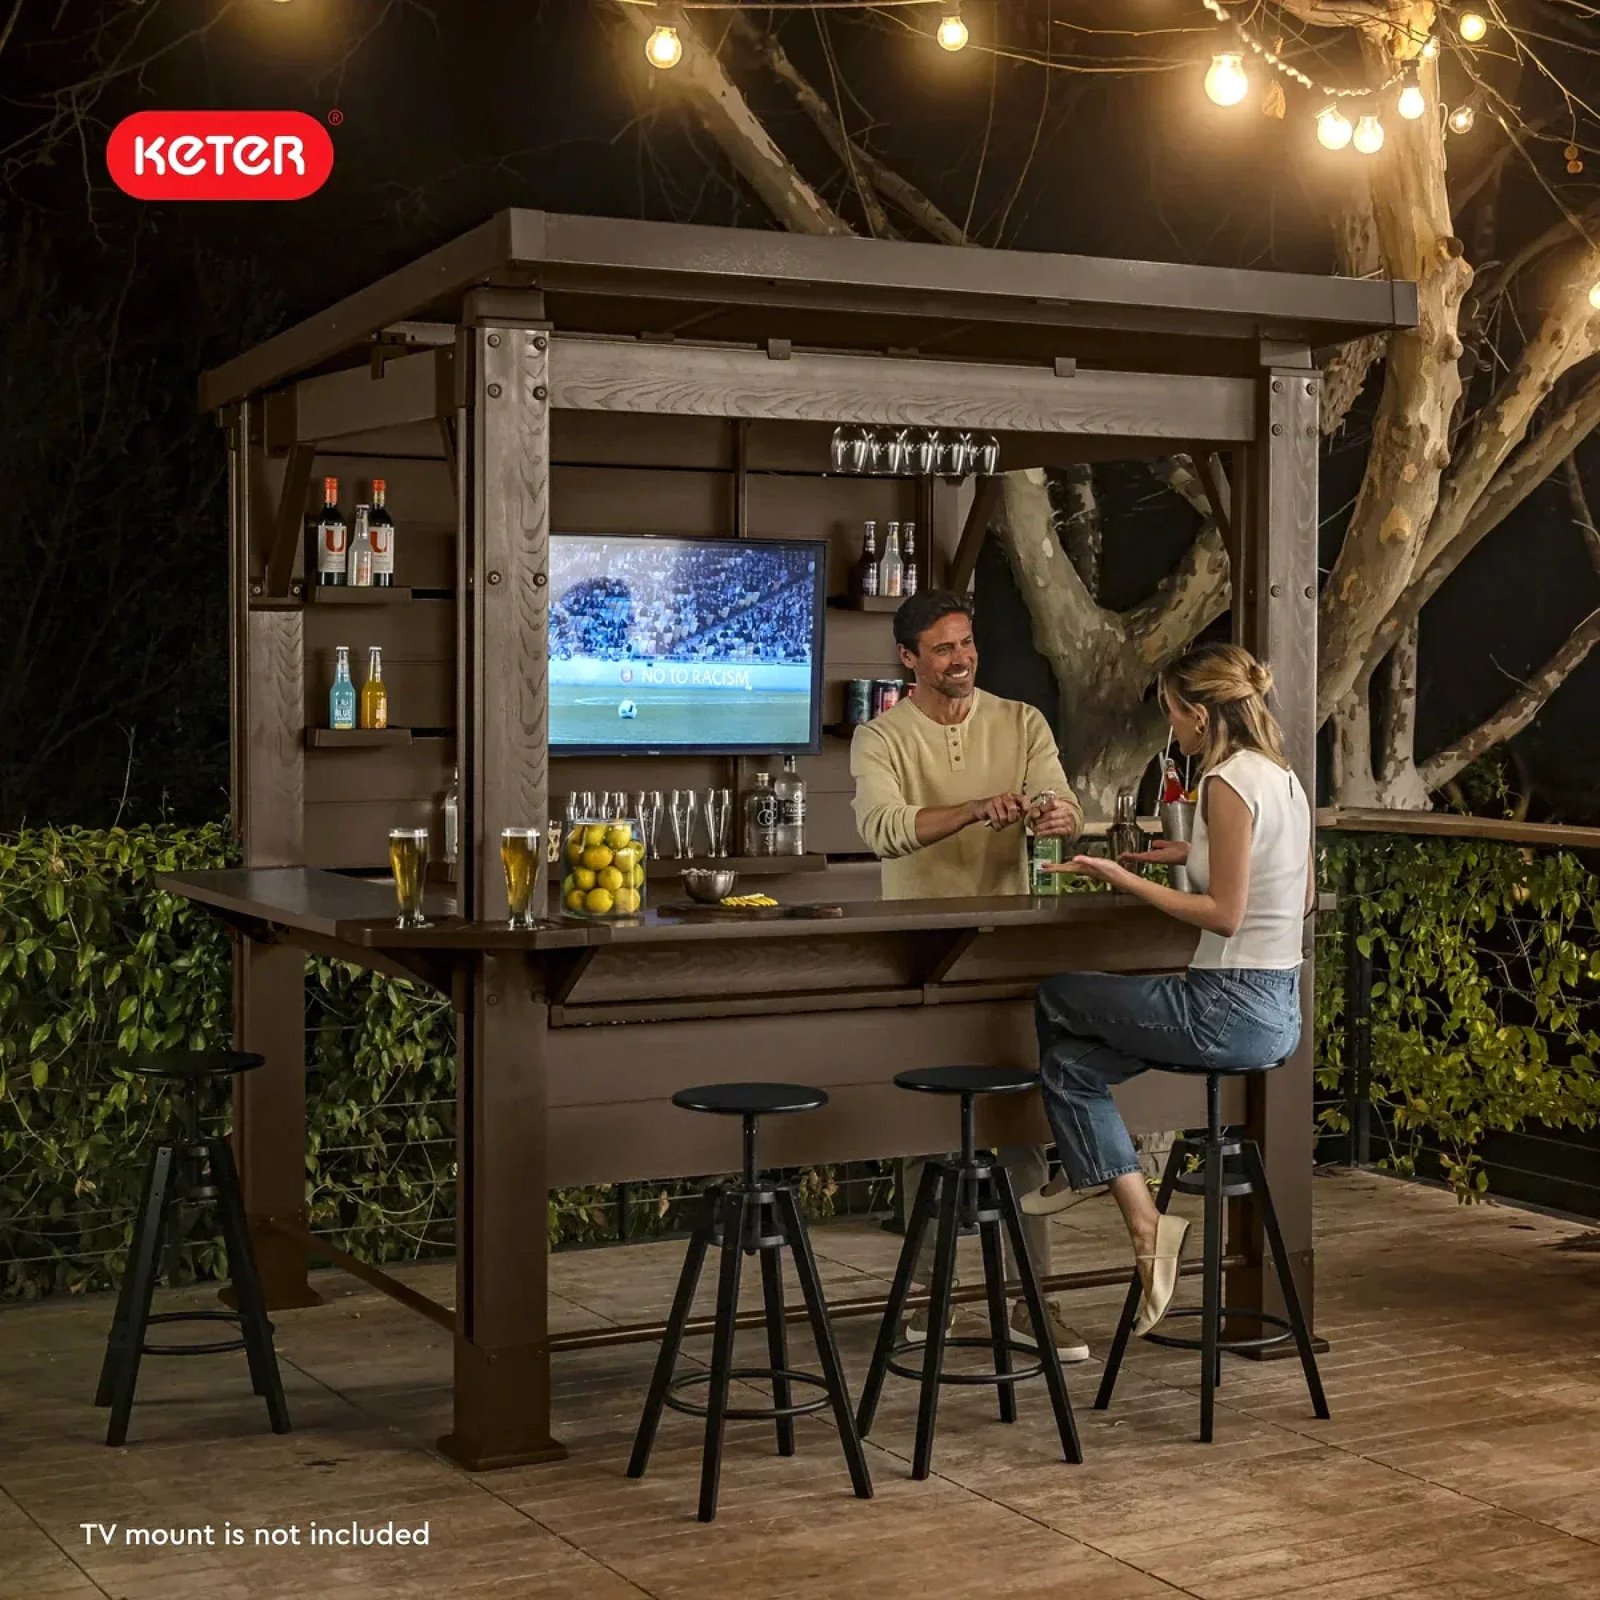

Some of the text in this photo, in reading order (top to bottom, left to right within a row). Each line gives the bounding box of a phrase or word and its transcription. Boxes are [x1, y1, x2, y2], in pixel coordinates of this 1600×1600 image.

[641, 668, 748, 686] NO TO RACISM
